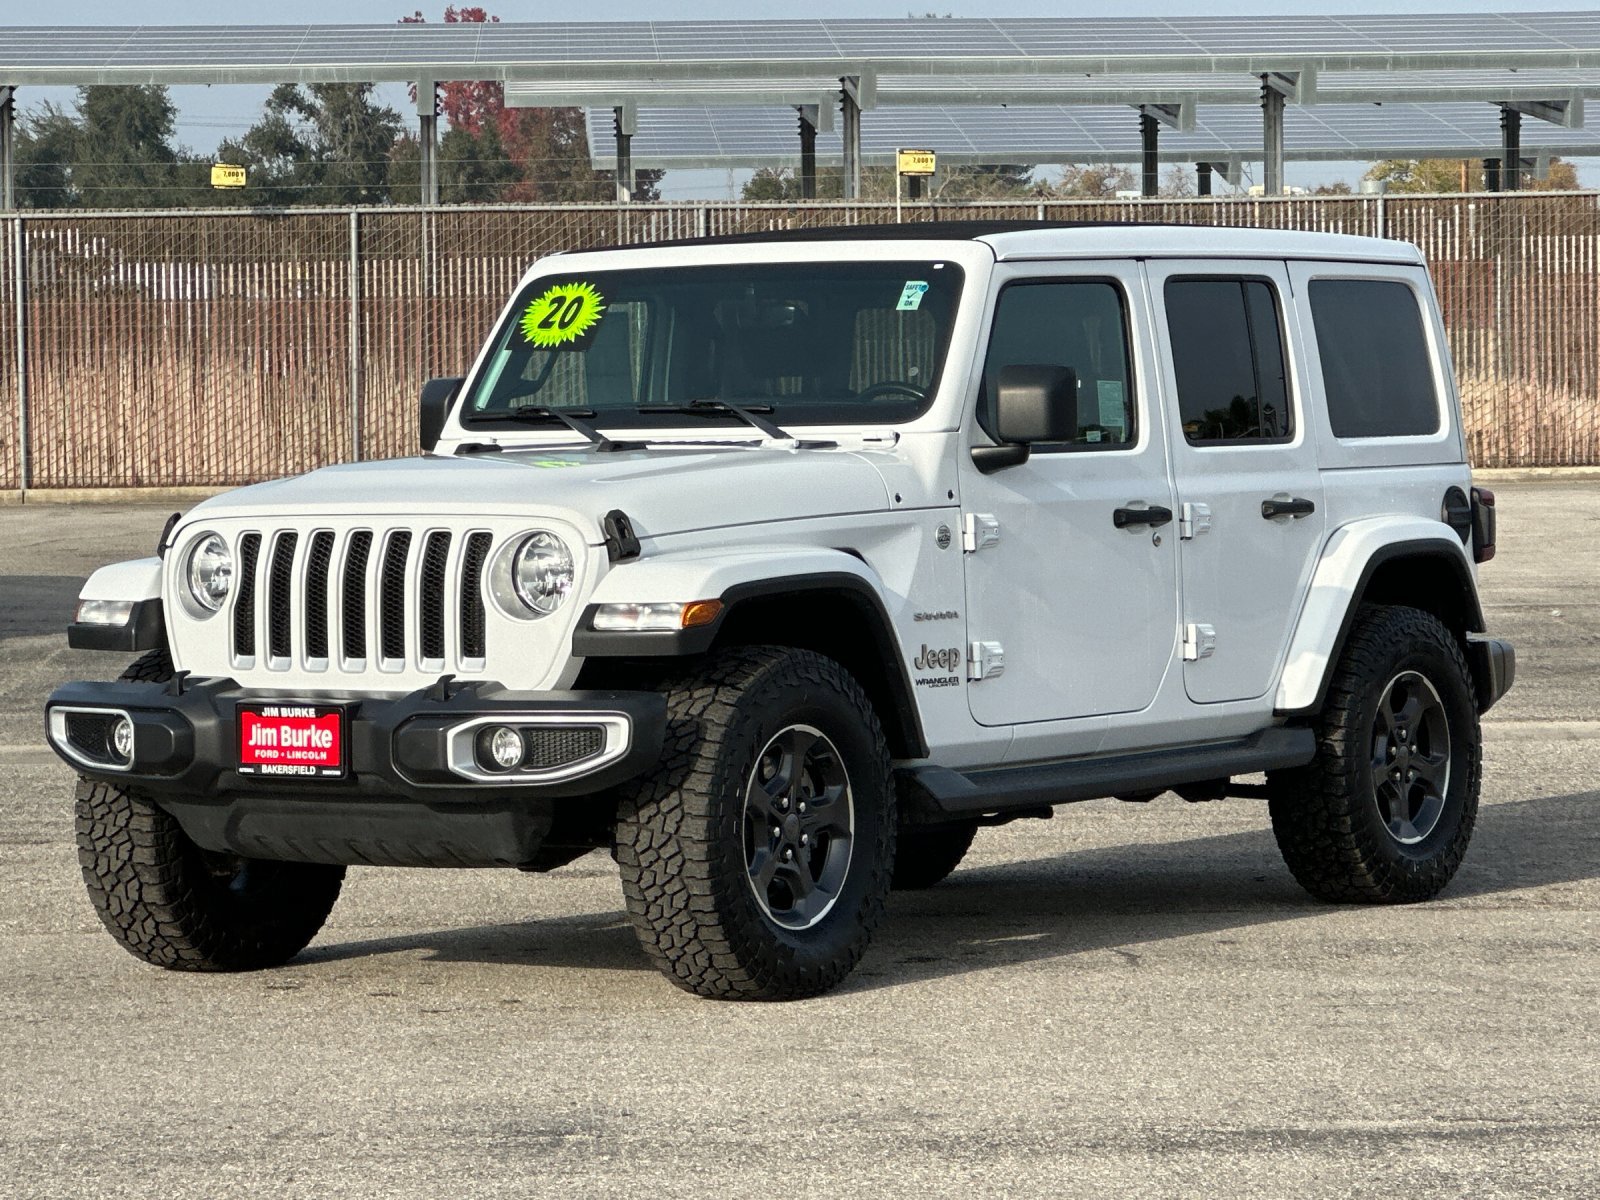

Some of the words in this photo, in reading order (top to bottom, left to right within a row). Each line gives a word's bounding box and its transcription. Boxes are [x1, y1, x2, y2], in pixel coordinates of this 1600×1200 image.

[537, 295, 585, 330] 20
[914, 644, 961, 672] Jeep
[915, 677, 959, 686] WRANGLER
[261, 707, 279, 717] JIM
[280, 708, 316, 718] BURKE
[248, 723, 278, 746] Jim
[280, 724, 333, 748] Burke
[255, 750, 279, 758] FORD
[286, 751, 327, 760] LINCOLN
[261, 764, 316, 774] BAKERSFIELD
